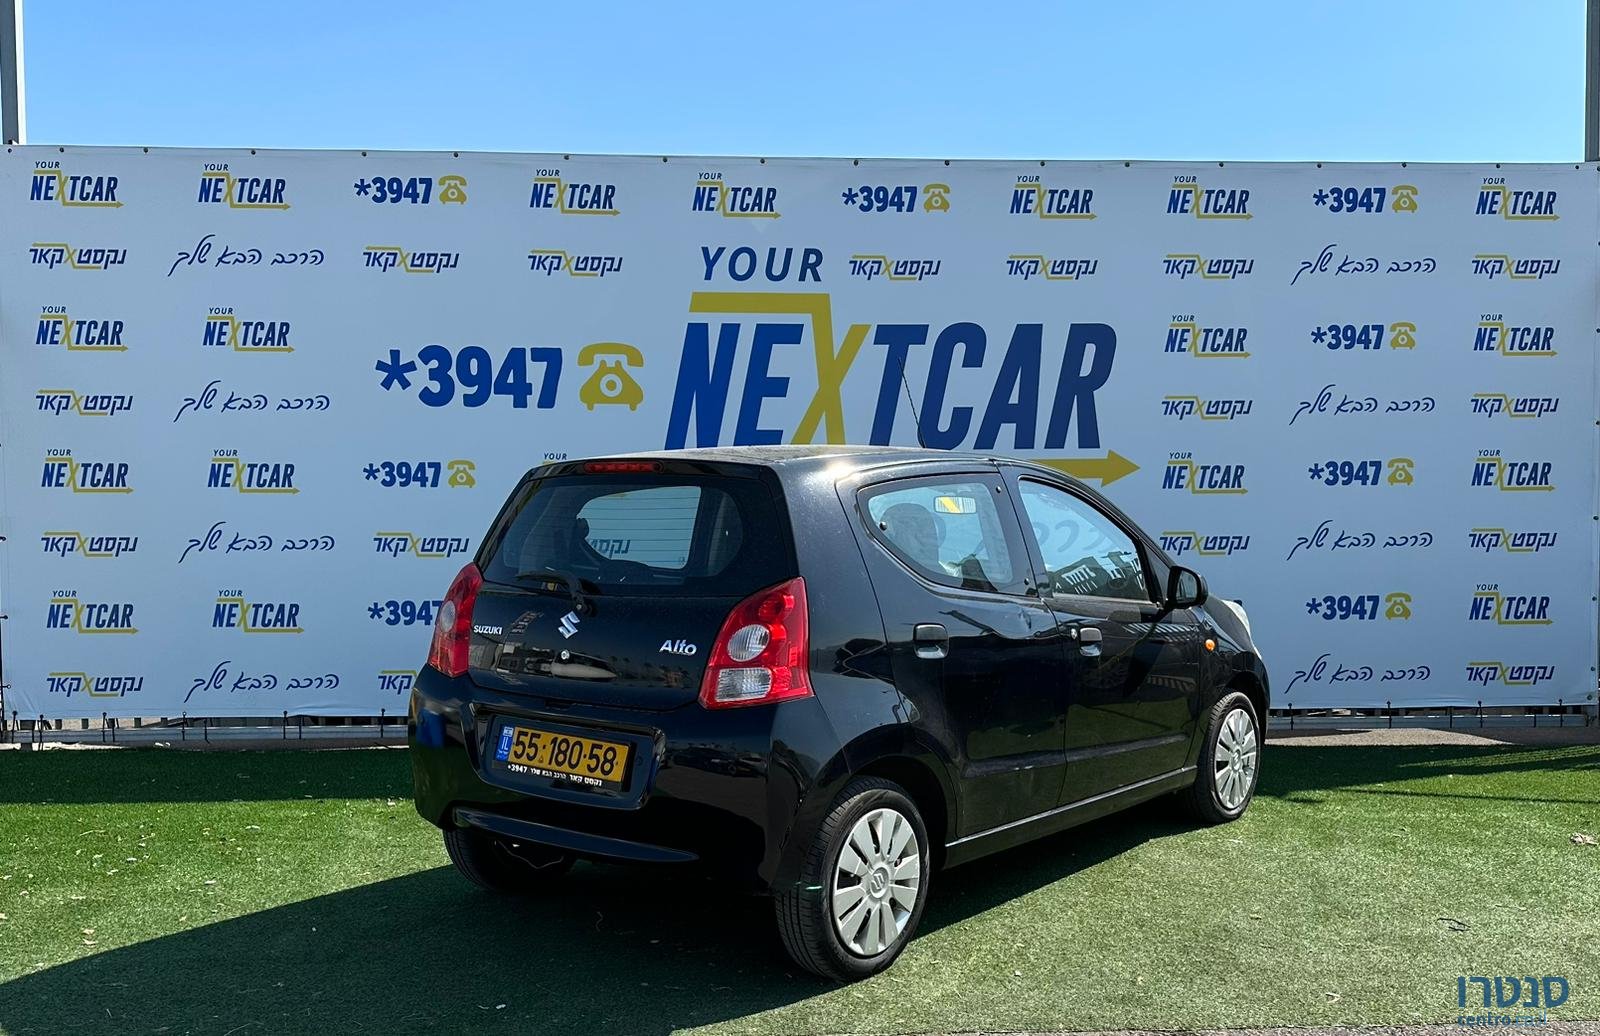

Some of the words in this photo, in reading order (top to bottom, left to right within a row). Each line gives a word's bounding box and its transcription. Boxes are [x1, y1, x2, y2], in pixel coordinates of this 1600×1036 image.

[34, 161, 60, 169] YOUR
[204, 163, 229, 172] YOUR
[535, 168, 560, 177] YOUR
[697, 172, 723, 183] YOUR
[1016, 175, 1040, 183] YOUR
[1174, 175, 1197, 183] YOUR
[1483, 177, 1506, 185] YOUR
[30, 176, 118, 201] NEXTCAR
[198, 178, 285, 203] NEXTCAR
[530, 183, 615, 209] NEXTCAR
[692, 187, 776, 212] NEXTCAR
[1010, 189, 1093, 214] NEXTCAR
[1167, 190, 1249, 213] NEXTCAR
[1476, 188, 1556, 215] NEXTCAR
[168, 235, 215, 276] שלך
[215, 246, 262, 267] הבא
[271, 250, 324, 265] הרכב
[701, 247, 823, 282] YOUR
[1291, 244, 1337, 285] שלך
[1335, 255, 1379, 275] הבא
[1386, 258, 1436, 273] הרכב
[42, 305, 67, 314] YOUR
[208, 307, 234, 315] YOUR
[1171, 314, 1195, 322] YOUR
[1480, 313, 1503, 321] YOUR
[36, 320, 123, 345] NEXTCAR
[203, 322, 290, 346] NEXTCAR
[1165, 328, 1247, 352] NEXTCAR
[1474, 327, 1554, 351] NEXTCAR
[666, 322, 1116, 449] NEXTCAR
[174, 380, 221, 422] שלך
[221, 392, 267, 412] הבא
[277, 395, 330, 411] הרכב
[1289, 384, 1336, 425] שלך
[1334, 395, 1377, 415] הבא
[1386, 397, 1435, 413] הרכב
[47, 448, 72, 457] YOUR
[213, 449, 238, 457] YOUR
[543, 452, 568, 461] YOUR
[1169, 451, 1193, 460] YOUR
[1478, 449, 1501, 457] YOUR
[42, 463, 128, 487] NEXTCAR
[208, 463, 294, 487] NEXTCAR
[1162, 465, 1244, 489] NEXTCAR
[1471, 462, 1551, 486] NEXTCAR
[178, 522, 226, 563] שלך
[226, 532, 272, 553] הבא
[281, 536, 335, 551] הרכב
[1287, 520, 1333, 561] שלך
[1331, 530, 1375, 551] הבא
[1383, 532, 1433, 548] הרכב
[52, 590, 77, 598] YOUR
[218, 589, 243, 598] YOUR
[1476, 583, 1499, 592] YOUR
[47, 604, 133, 628] NEXTCAR
[212, 603, 299, 627] NEXTCAR
[1469, 594, 1549, 621] NEXTCAR
[473, 624, 503, 636] SUZUKI
[658, 639, 698, 656] Alto
[184, 661, 231, 703] שלך
[231, 672, 277, 693] הבא
[286, 674, 339, 690] הרכב
[1284, 654, 1331, 696] שלך
[1330, 666, 1374, 687] הבא
[1381, 667, 1430, 684] הרכב
